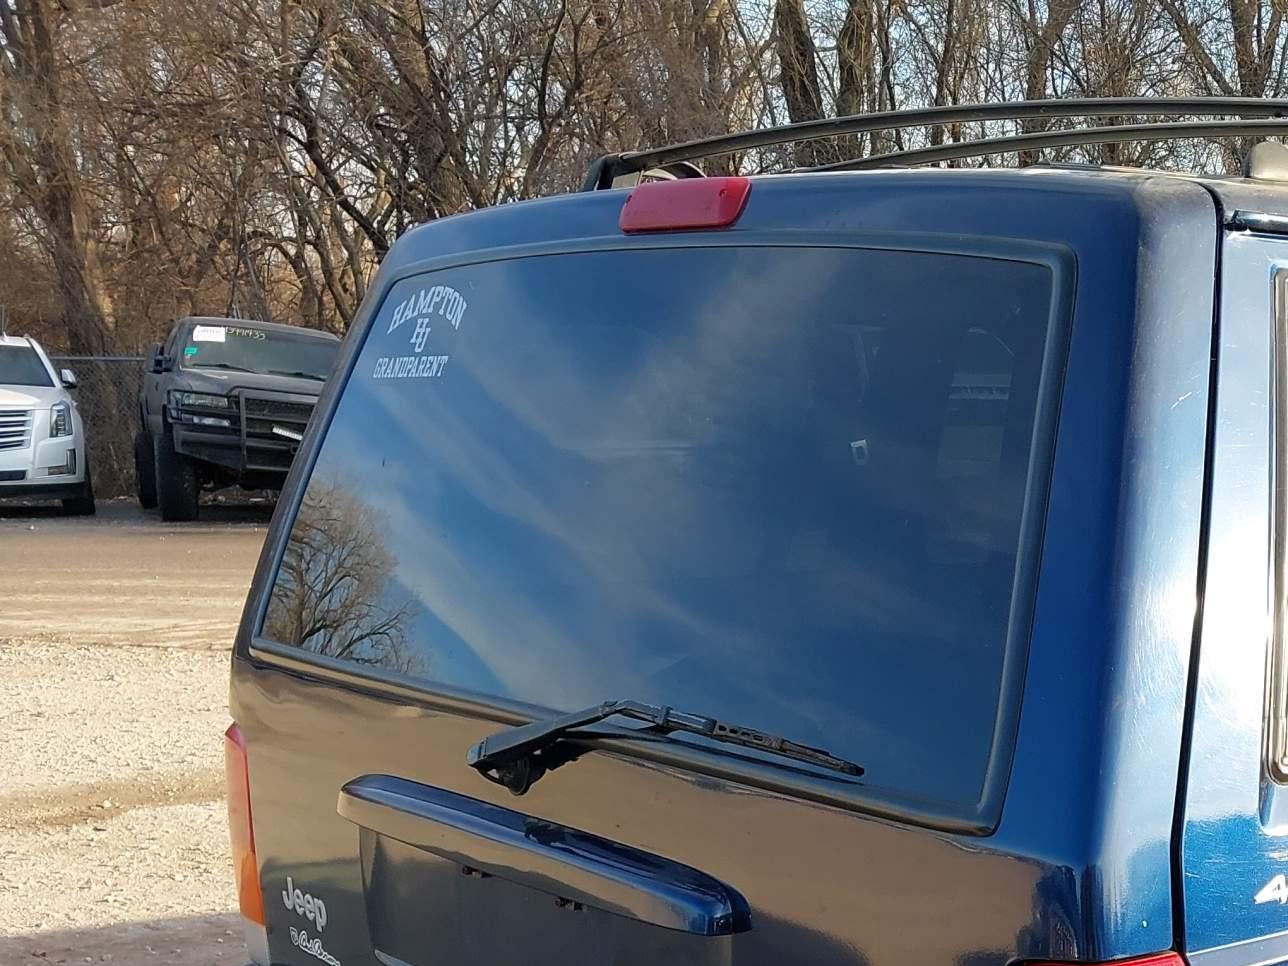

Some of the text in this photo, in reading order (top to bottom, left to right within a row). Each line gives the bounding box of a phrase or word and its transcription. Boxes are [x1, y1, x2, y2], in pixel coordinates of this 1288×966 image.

[386, 285, 468, 335] HAMPTON
[373, 355, 449, 379] GRANDPARENT
[282, 876, 327, 933] Jeep
